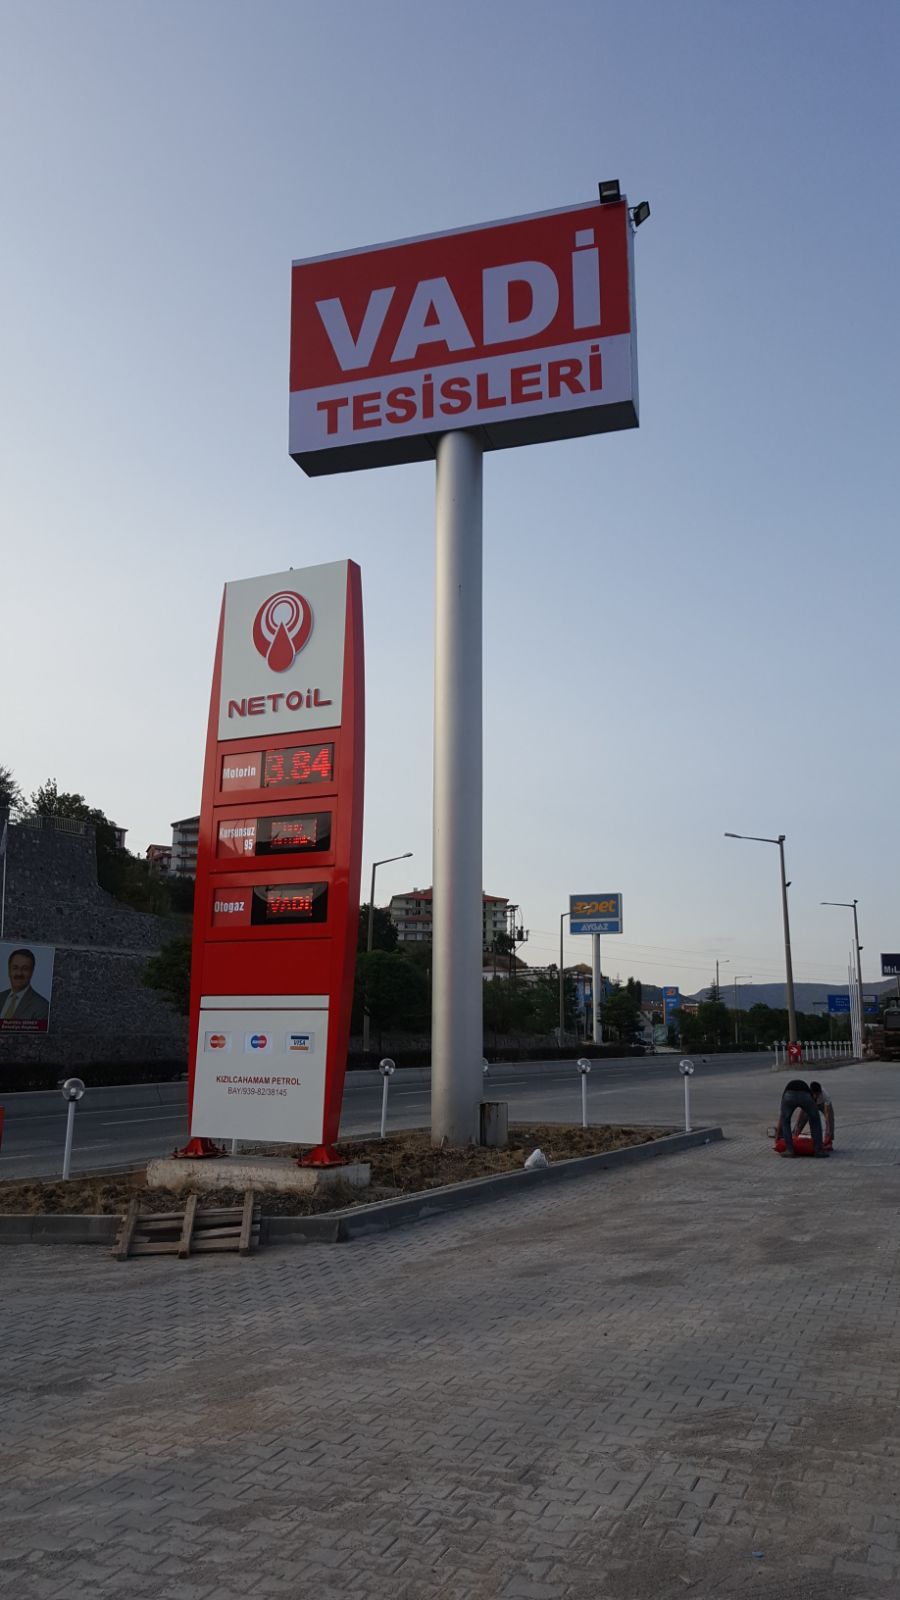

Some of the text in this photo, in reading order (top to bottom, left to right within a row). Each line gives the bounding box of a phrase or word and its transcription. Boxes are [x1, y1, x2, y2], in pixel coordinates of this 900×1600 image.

[315, 228, 601, 372] VADİ
[316, 345, 603, 435] TESİSLERİ
[265, 748, 332, 784] 3.84
[223, 766, 256, 779] Motorin
[244, 839, 253, 850] 95
[214, 901, 245, 913] Otogaz
[580, 923, 609, 931] AYGAZ
[216, 1075, 301, 1086] KIZILCAHAMAM PETROL
